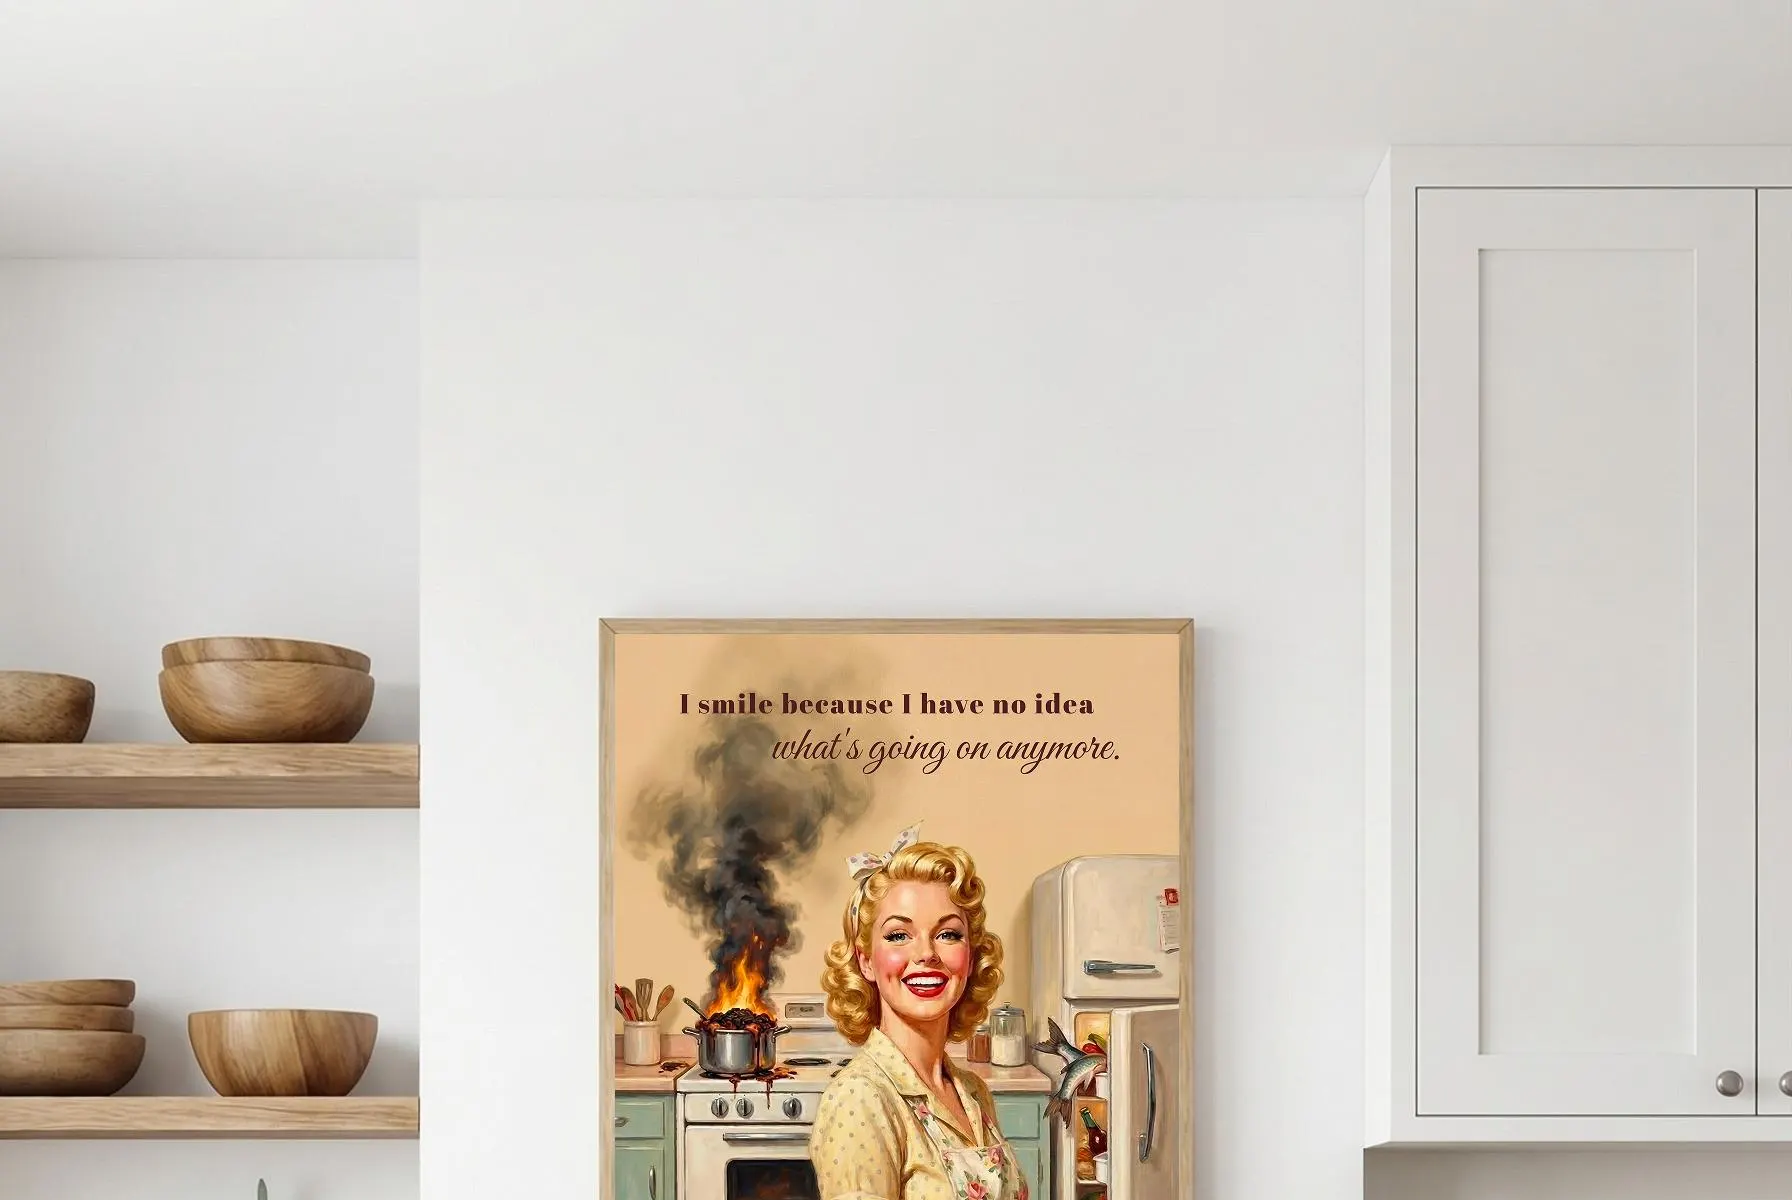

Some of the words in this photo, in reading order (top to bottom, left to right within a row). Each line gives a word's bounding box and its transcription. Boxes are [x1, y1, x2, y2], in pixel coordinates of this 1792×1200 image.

[680, 693, 689, 714] I
[698, 692, 773, 715] smile
[782, 692, 893, 715] because
[902, 693, 911, 714] I
[921, 692, 984, 715] have
[993, 699, 1027, 715] no
[1035, 692, 1095, 715] idea
[771, 727, 863, 760] what's
[862, 735, 951, 775] going
[956, 741, 992, 760] on
[996, 736, 1120, 775] anymore.
